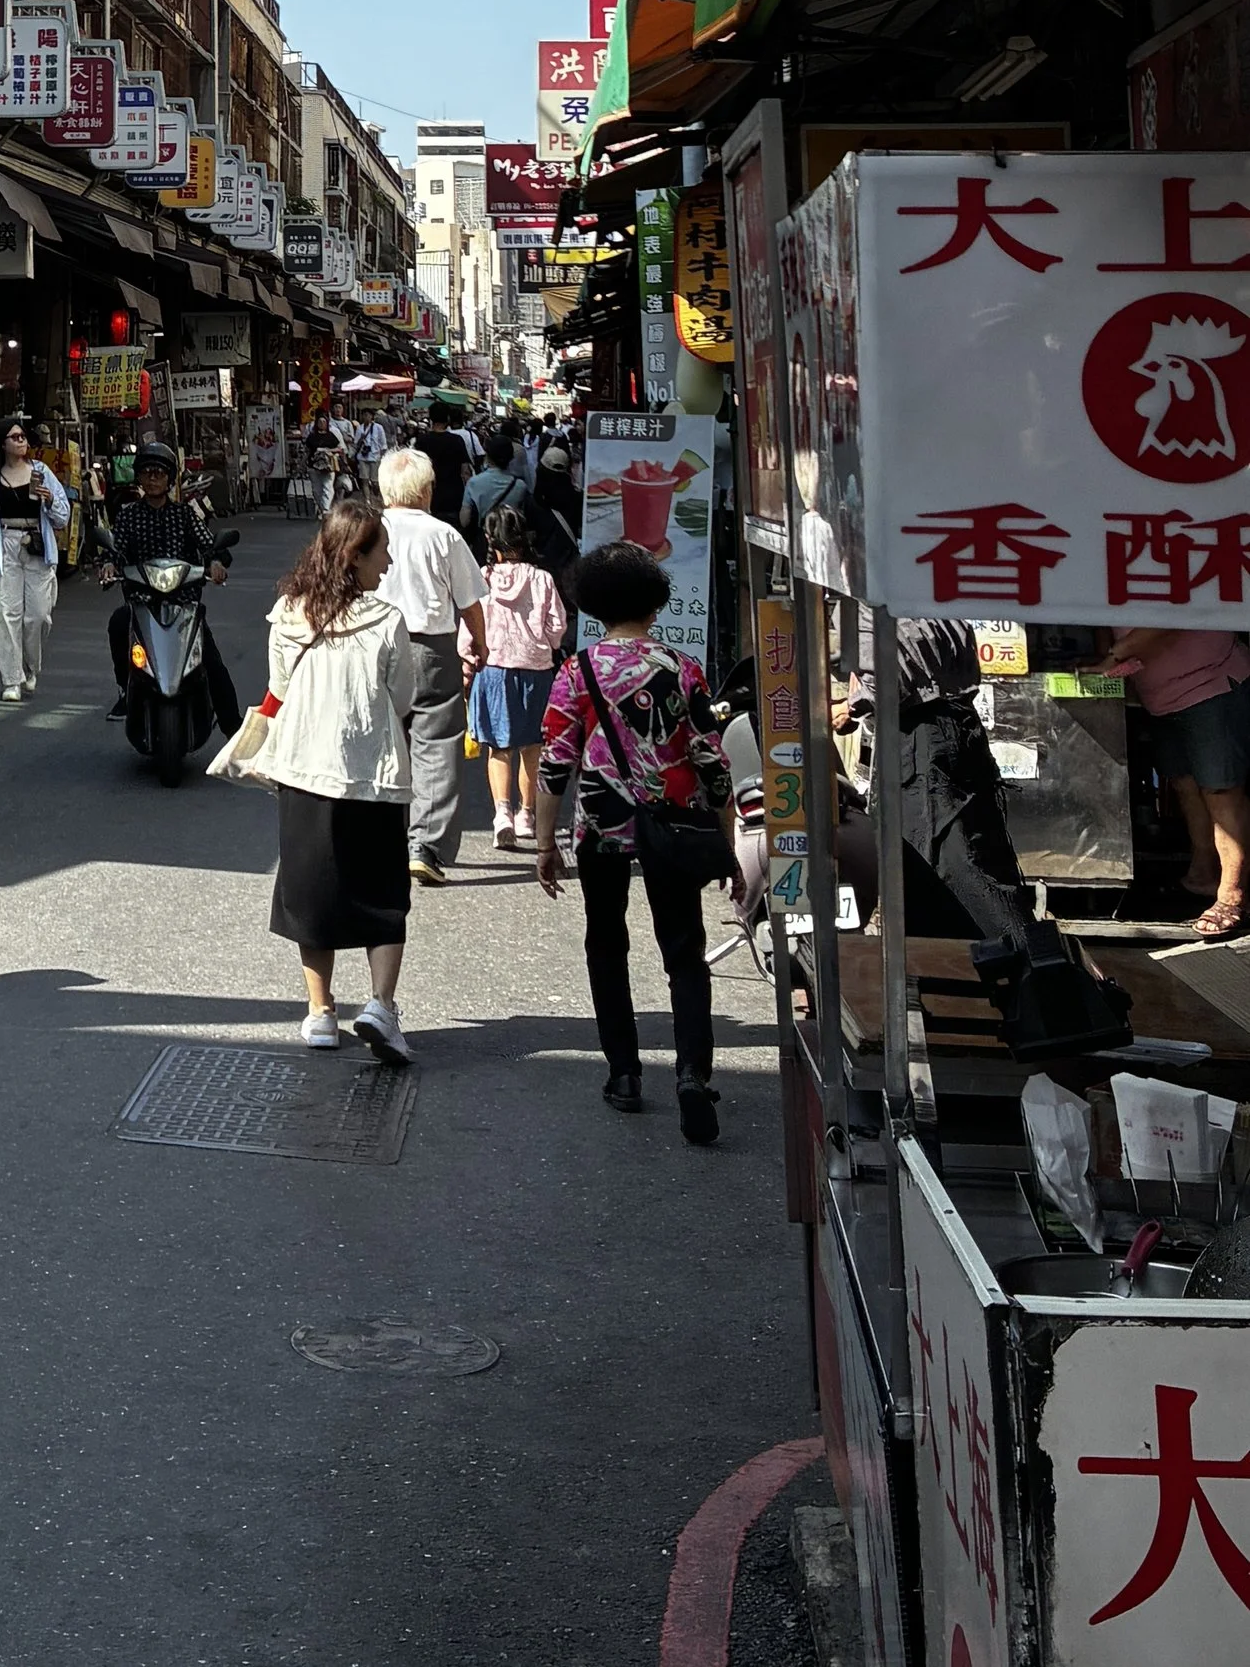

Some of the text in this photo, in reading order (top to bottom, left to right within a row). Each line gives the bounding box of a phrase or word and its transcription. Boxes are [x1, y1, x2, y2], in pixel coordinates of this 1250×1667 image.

[897, 177, 1250, 275] 大上
[599, 417, 665, 438] 鮮榨果汁
[900, 502, 1250, 607] 香酥
[770, 772, 806, 819] 3
[1077, 1384, 1250, 1626] 大
